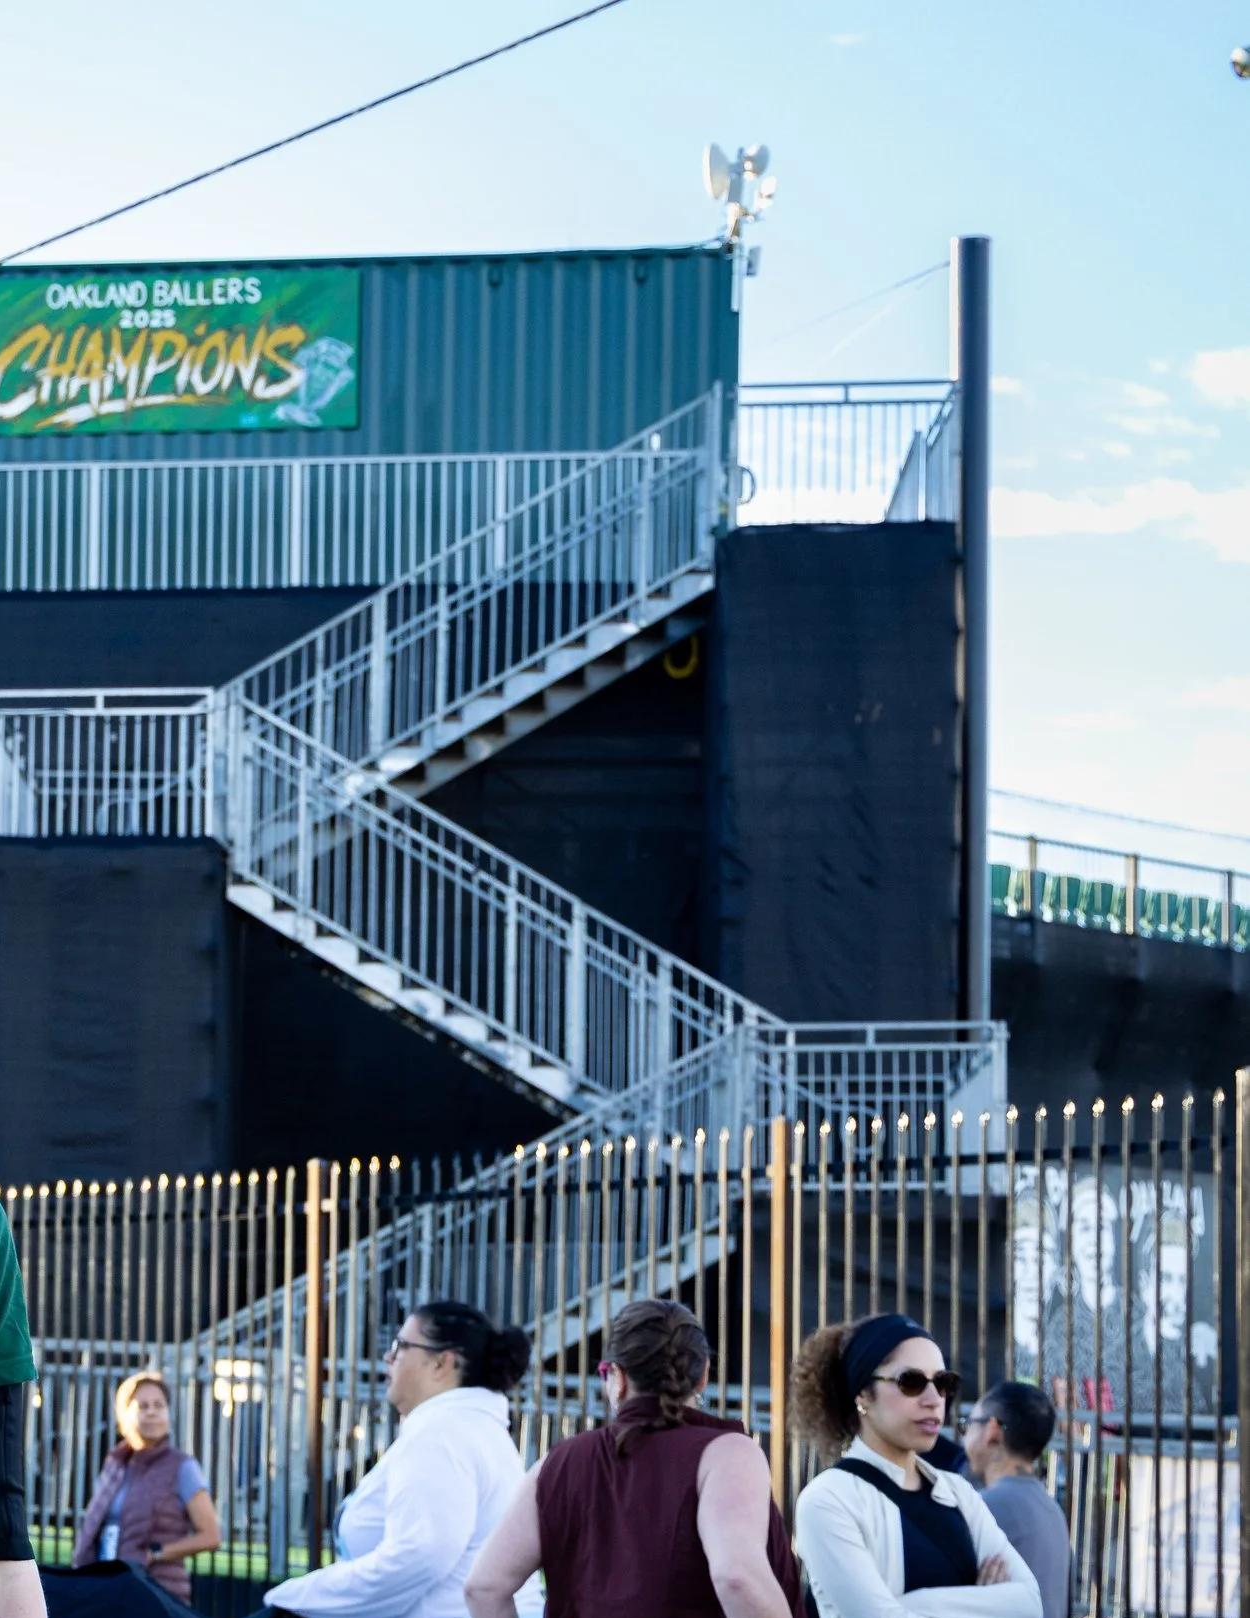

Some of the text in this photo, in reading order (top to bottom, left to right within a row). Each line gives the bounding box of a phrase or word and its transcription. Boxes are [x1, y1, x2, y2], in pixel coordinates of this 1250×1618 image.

[46, 277, 262, 310] OAKLAND BALLERS
[119, 309, 176, 329] 2025
